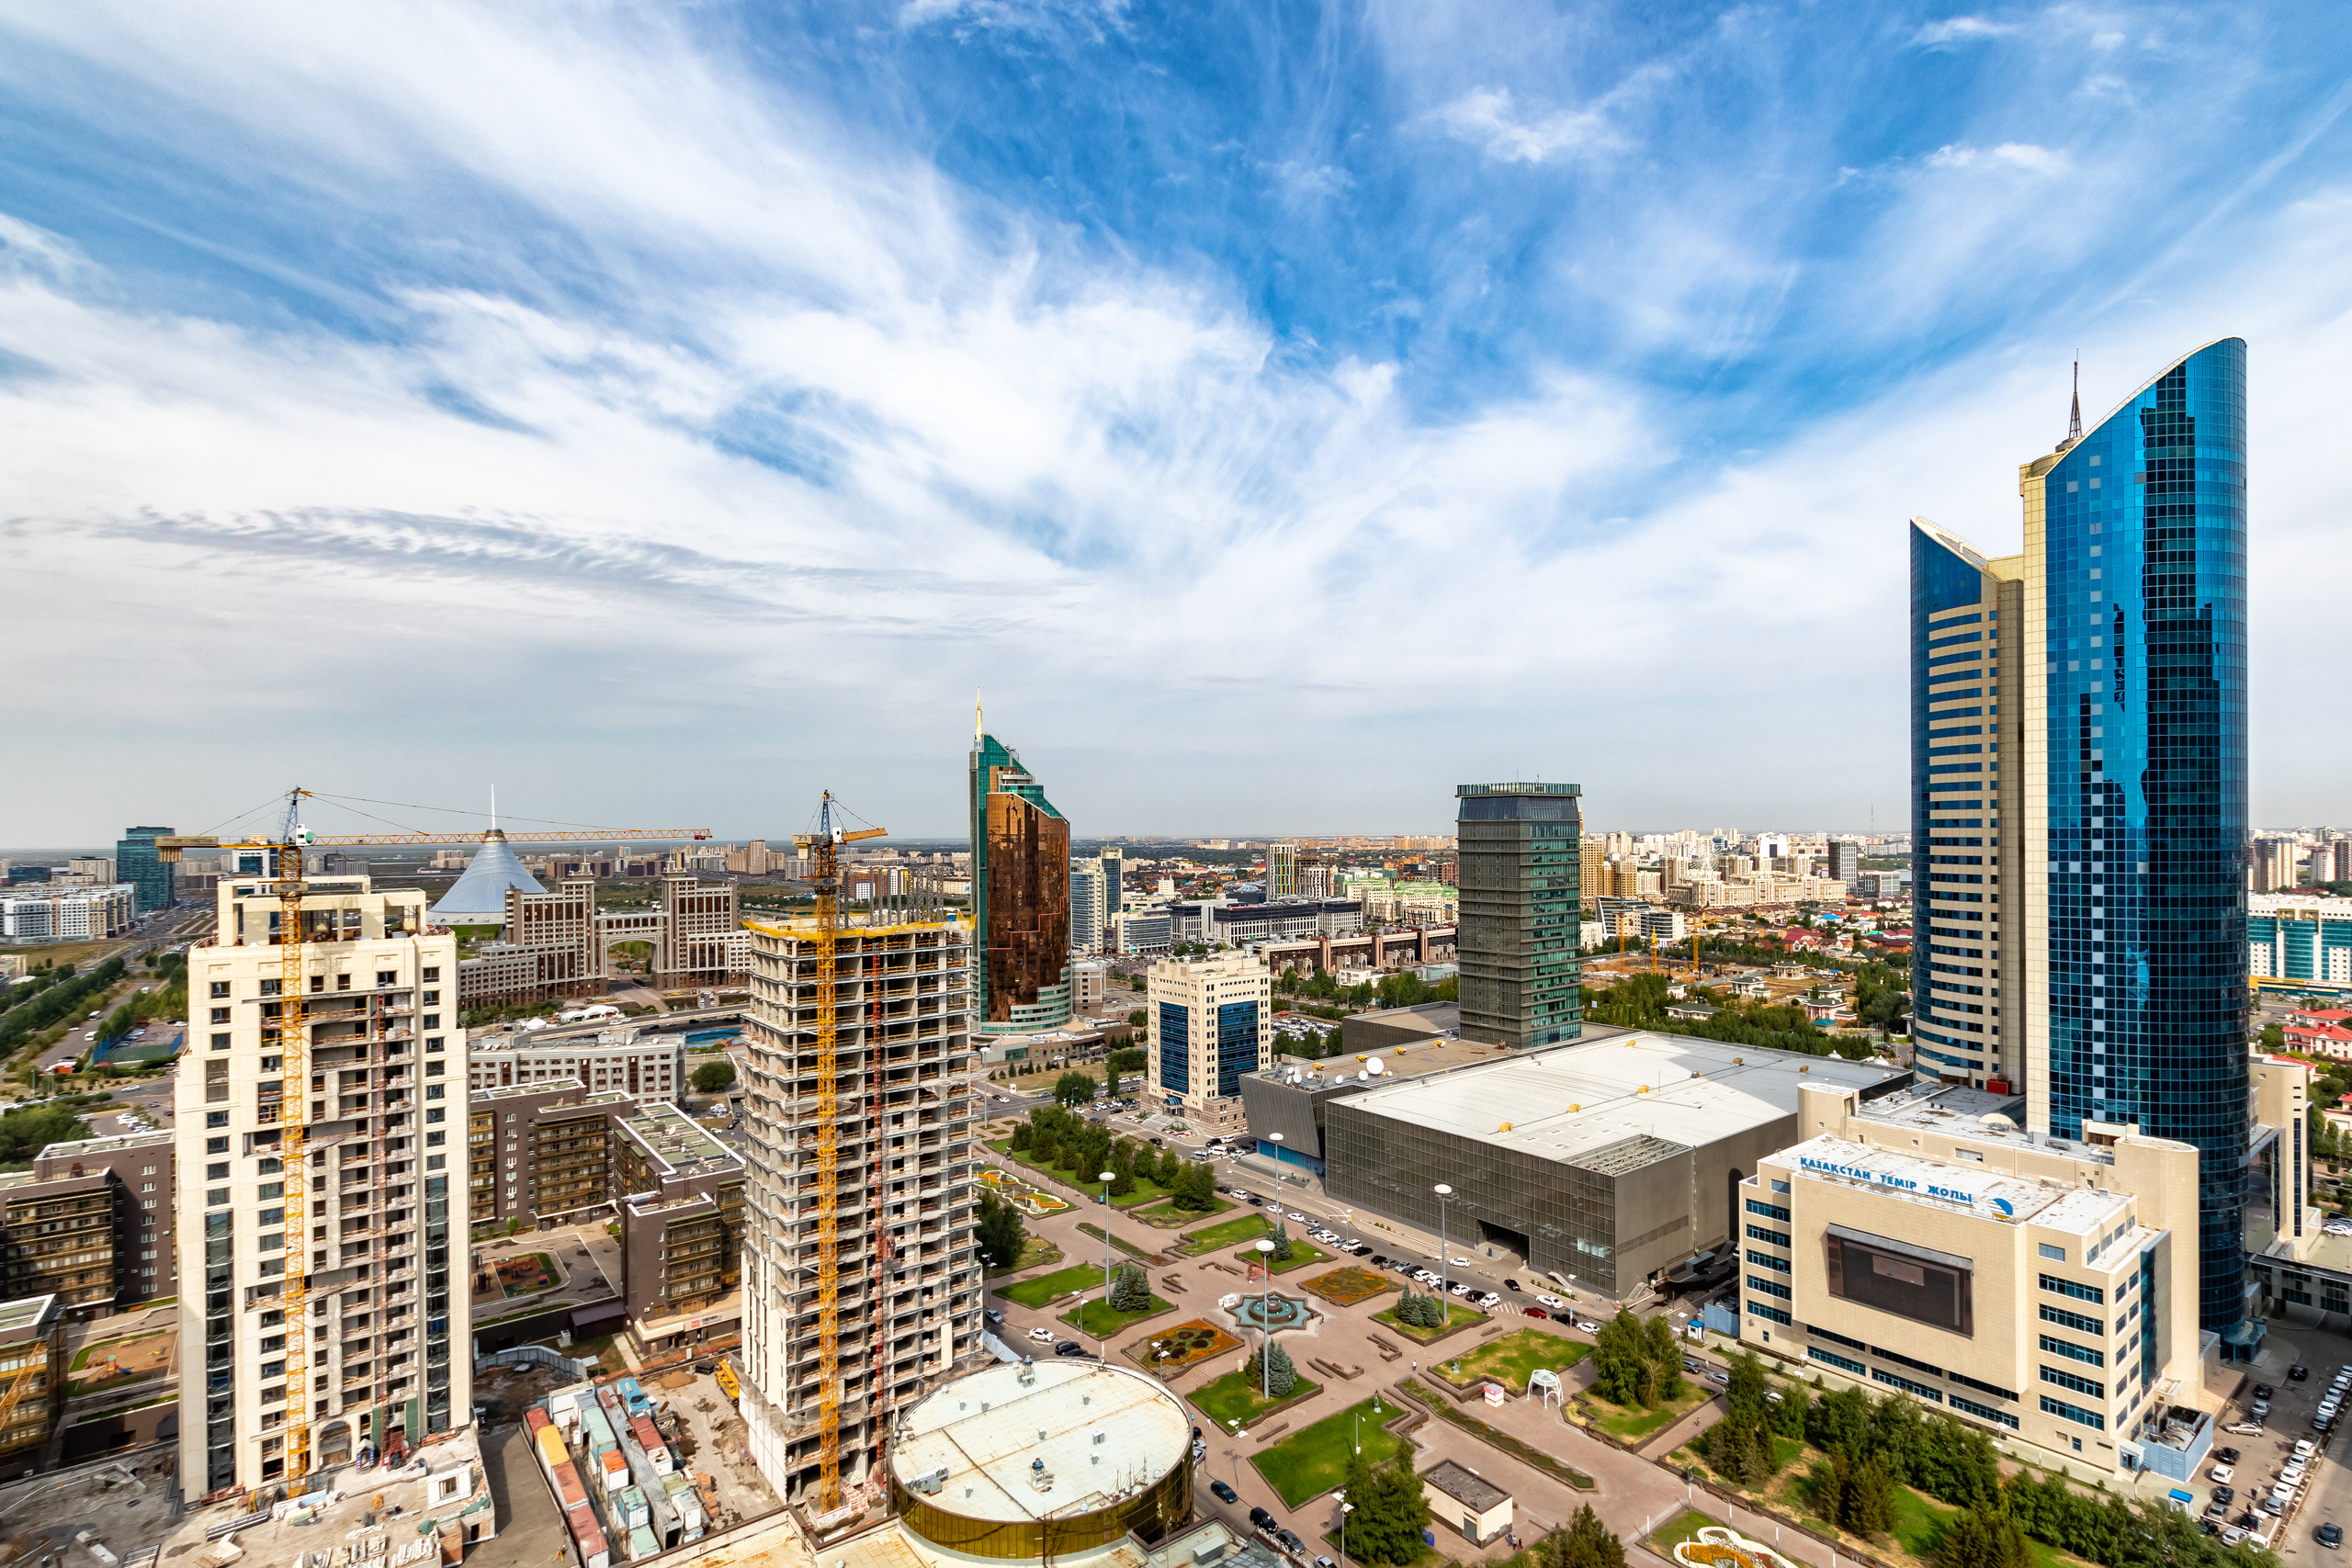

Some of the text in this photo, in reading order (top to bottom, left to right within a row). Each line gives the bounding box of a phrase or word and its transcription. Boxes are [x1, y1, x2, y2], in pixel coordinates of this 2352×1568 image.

[1801, 1157, 1973, 1202] ҚАЗАҚСТАН ТЕМІР ЖОЛЫ
